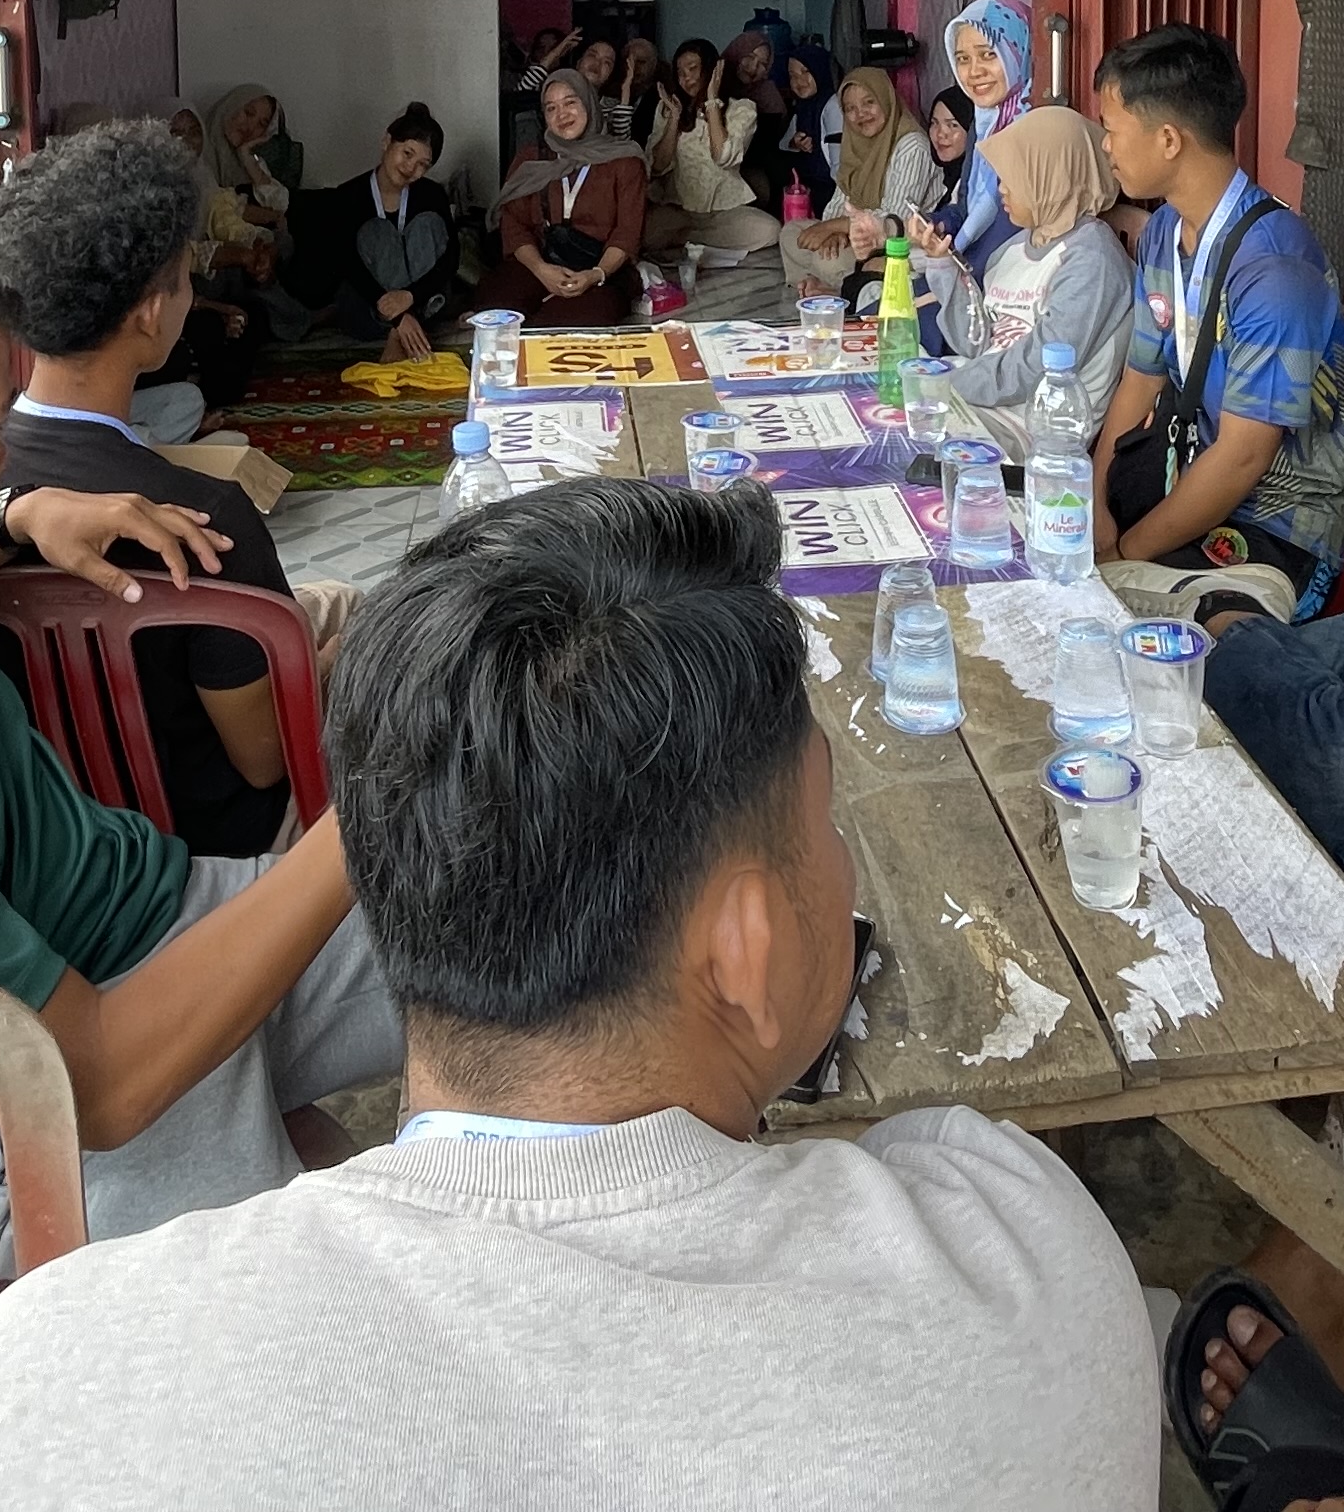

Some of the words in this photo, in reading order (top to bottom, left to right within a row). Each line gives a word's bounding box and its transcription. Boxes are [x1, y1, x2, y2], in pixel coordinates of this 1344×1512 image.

[494, 411, 534, 453] WIN
[539, 412, 561, 445] CLICK
[744, 403, 792, 444] WIN
[784, 406, 818, 437] CLICK
[783, 499, 839, 557] WIN
[827, 503, 869, 546] CLICK
[1061, 514, 1074, 525] Le
